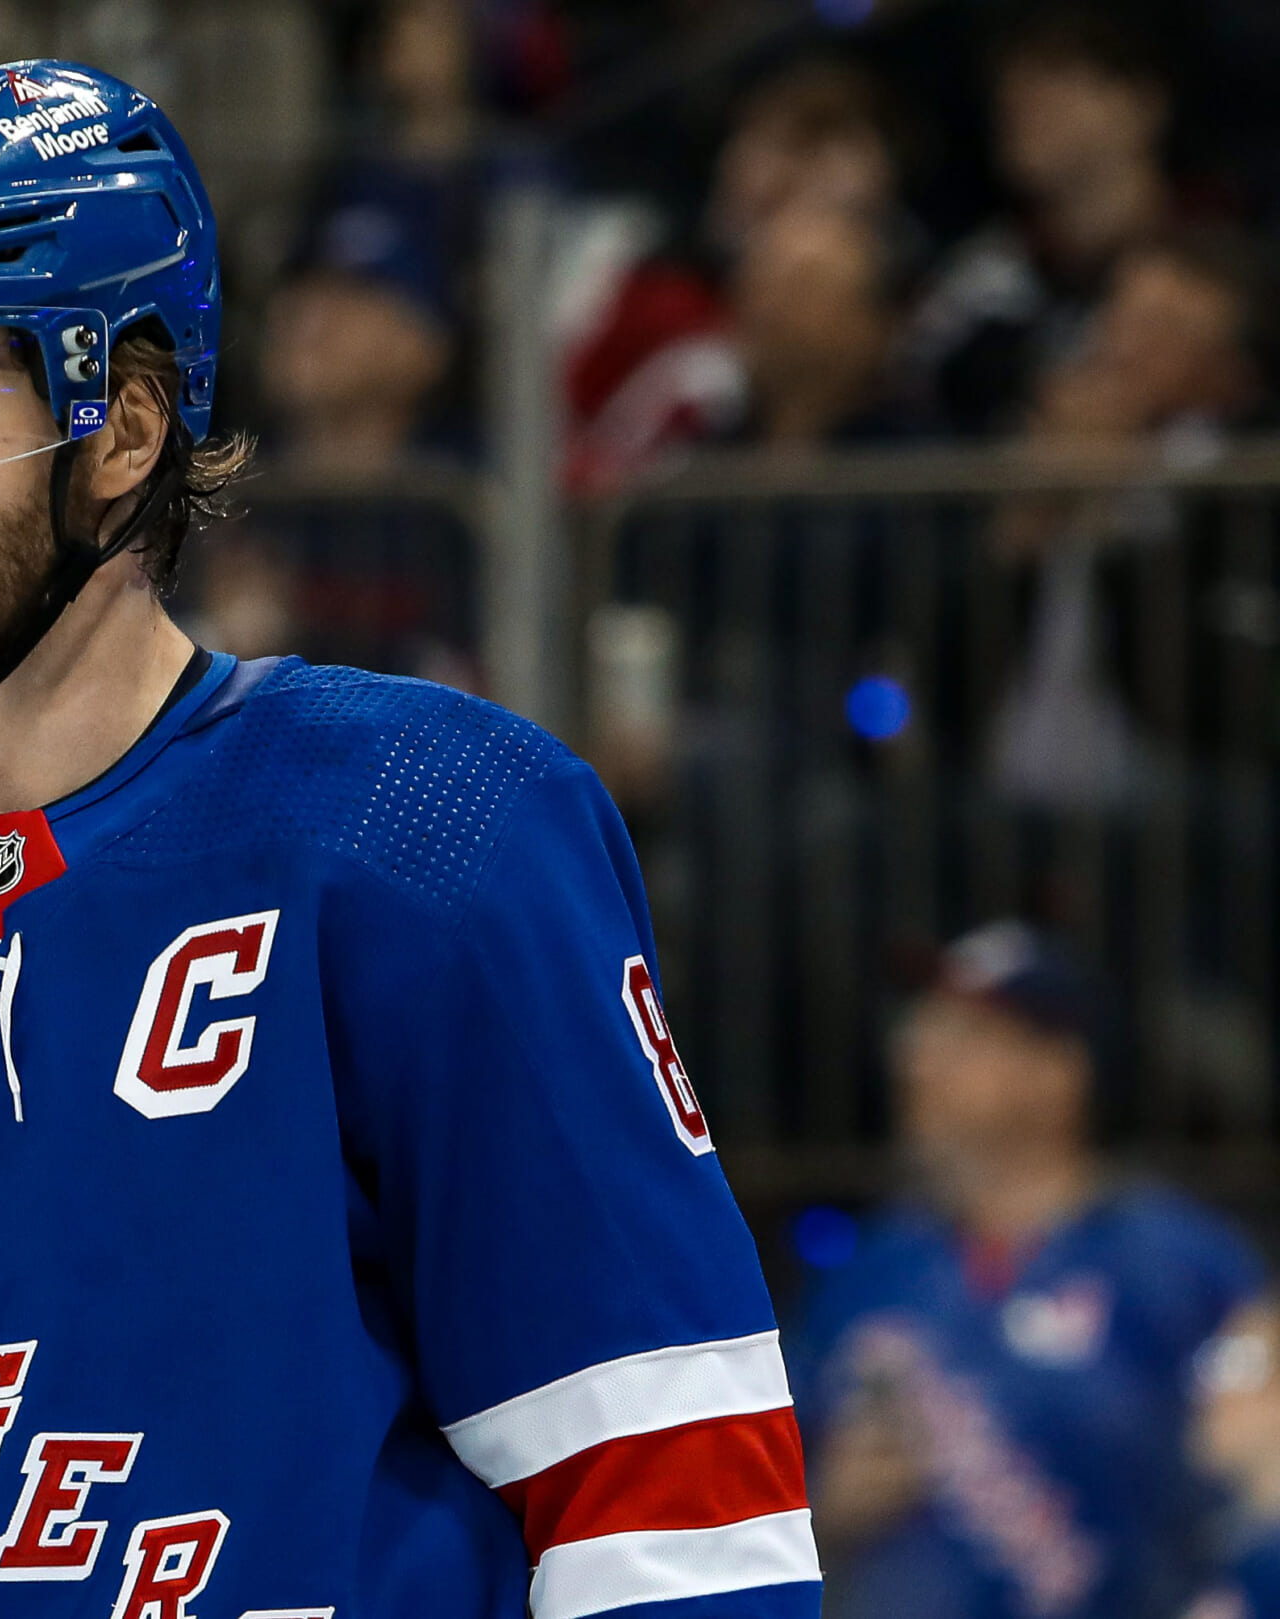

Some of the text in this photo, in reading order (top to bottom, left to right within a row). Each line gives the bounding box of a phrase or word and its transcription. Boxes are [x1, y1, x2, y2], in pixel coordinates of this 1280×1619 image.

[31, 123, 108, 161] Moore
[112, 908, 281, 1120] C
[621, 953, 717, 1157] 8
